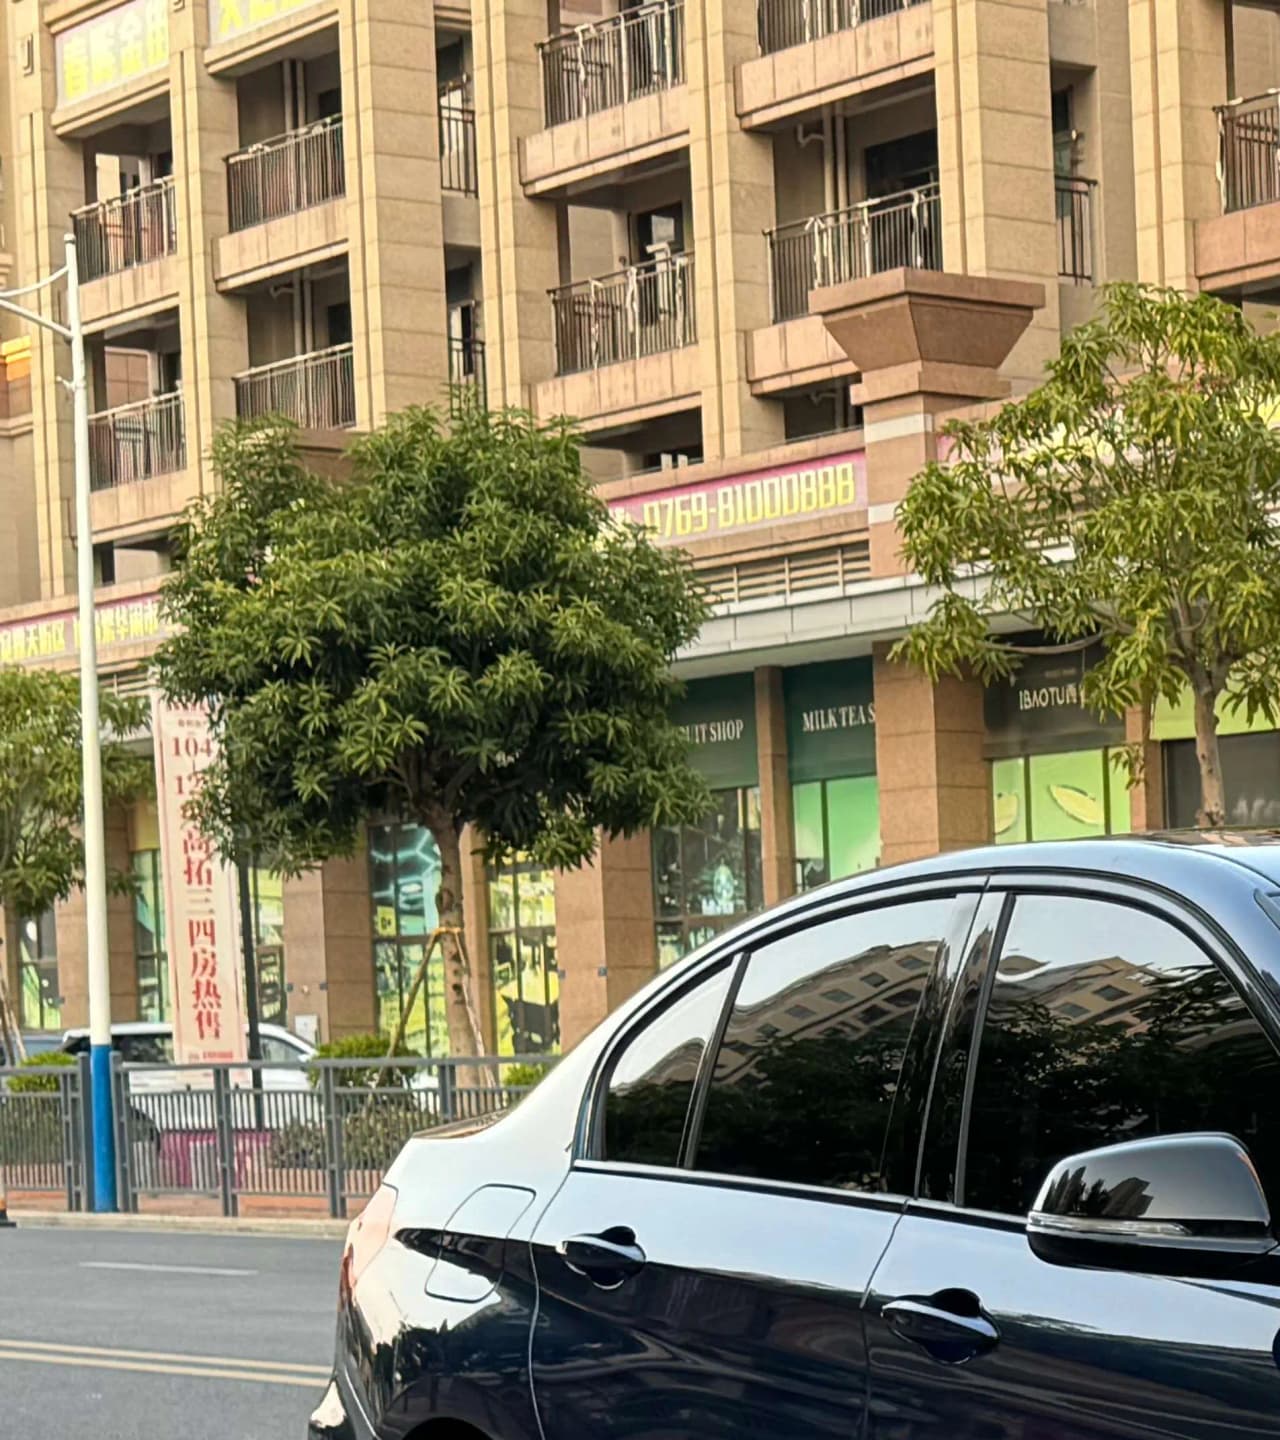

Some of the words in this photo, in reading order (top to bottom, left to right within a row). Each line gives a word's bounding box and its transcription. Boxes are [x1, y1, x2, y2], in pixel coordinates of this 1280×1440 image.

[709, 719, 744, 743] SHOP
[803, 708, 838, 732] MILK
[838, 704, 864, 728] TEA
